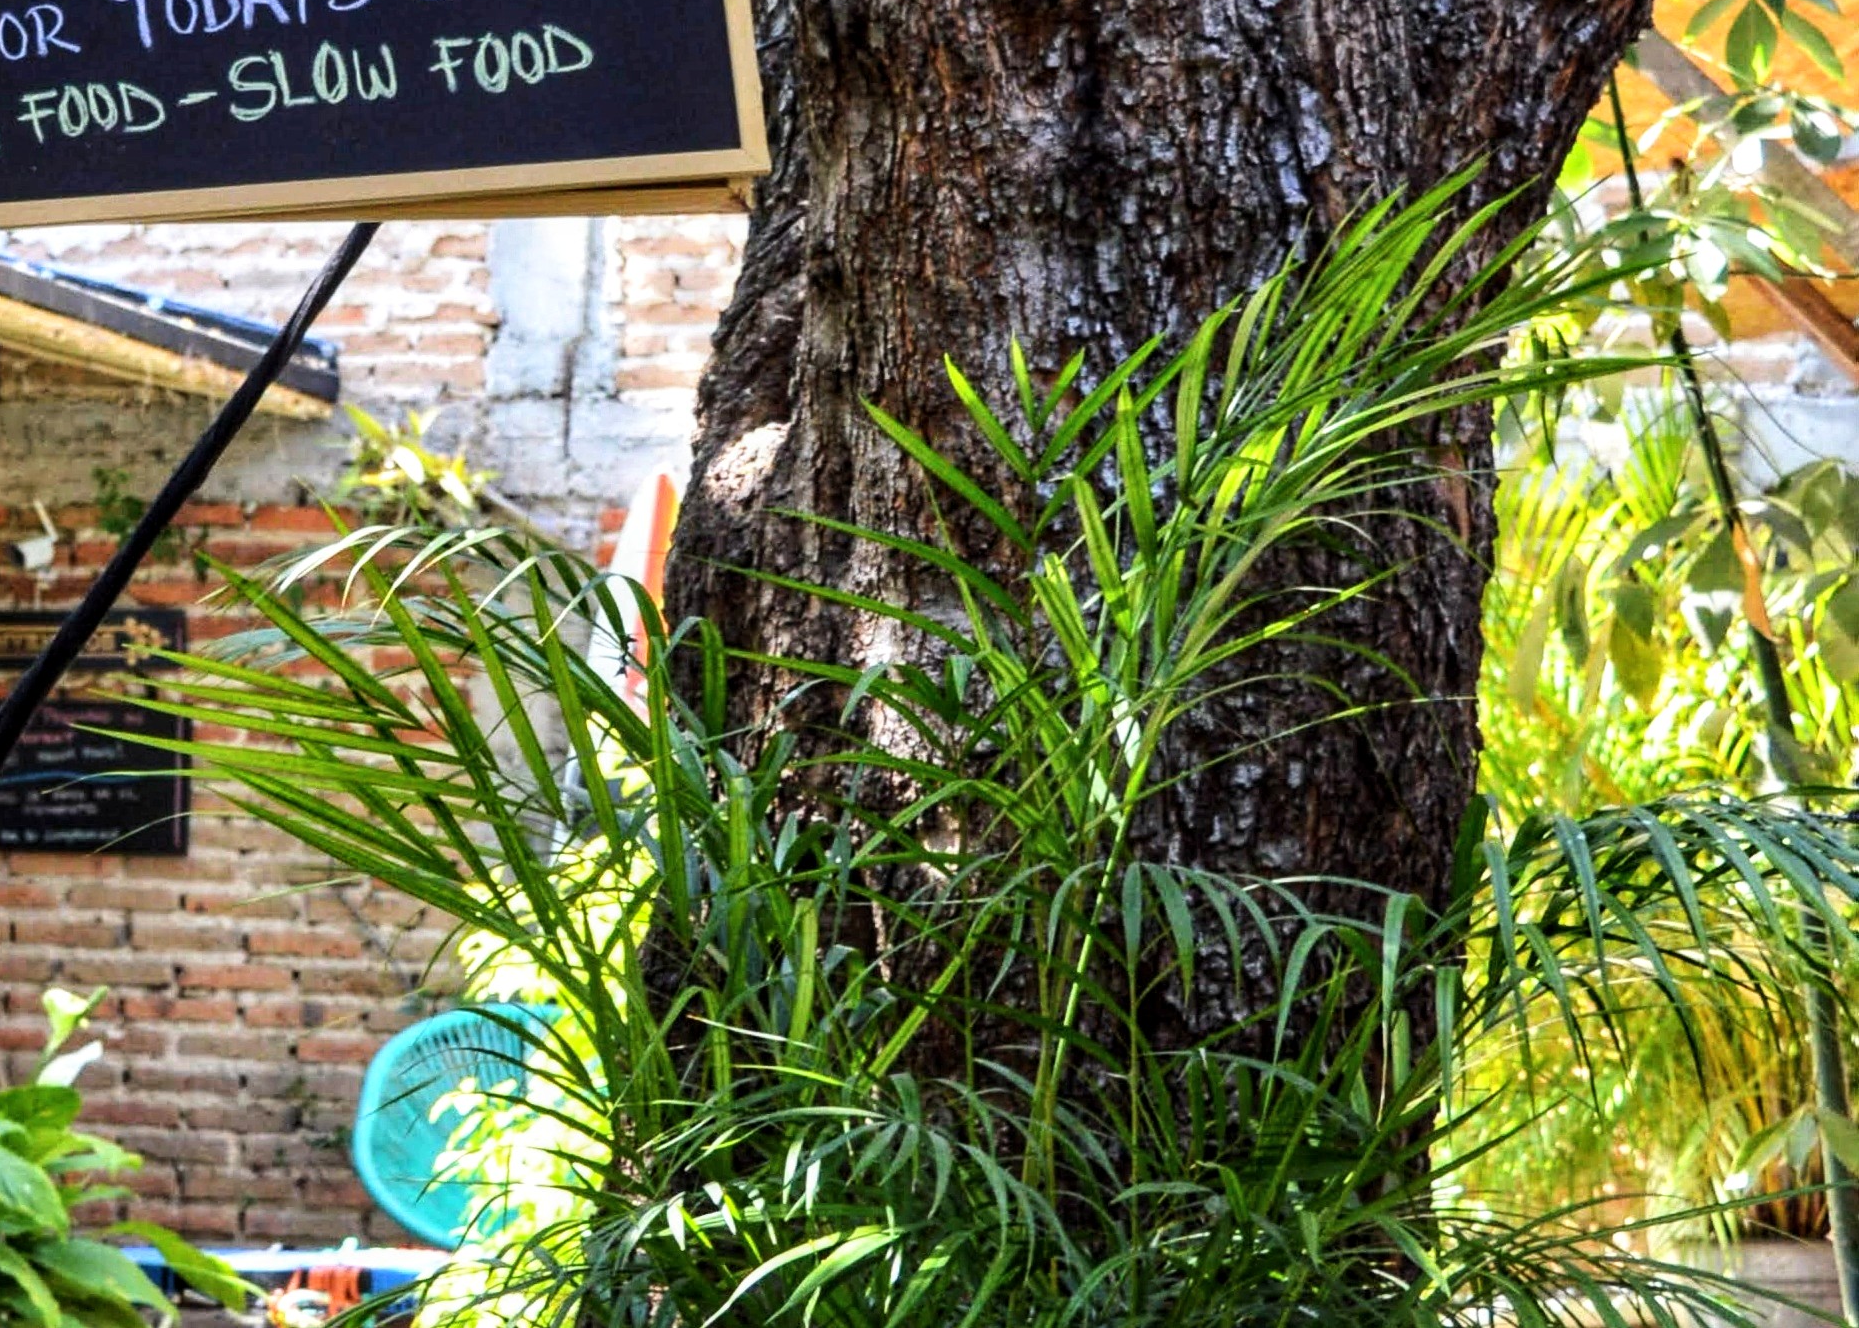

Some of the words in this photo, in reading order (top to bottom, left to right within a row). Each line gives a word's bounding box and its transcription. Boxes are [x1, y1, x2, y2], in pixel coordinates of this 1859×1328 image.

[15, 81, 167, 145] FOOD
[226, 40, 399, 122] SLOW
[427, 23, 595, 95] FOOD
